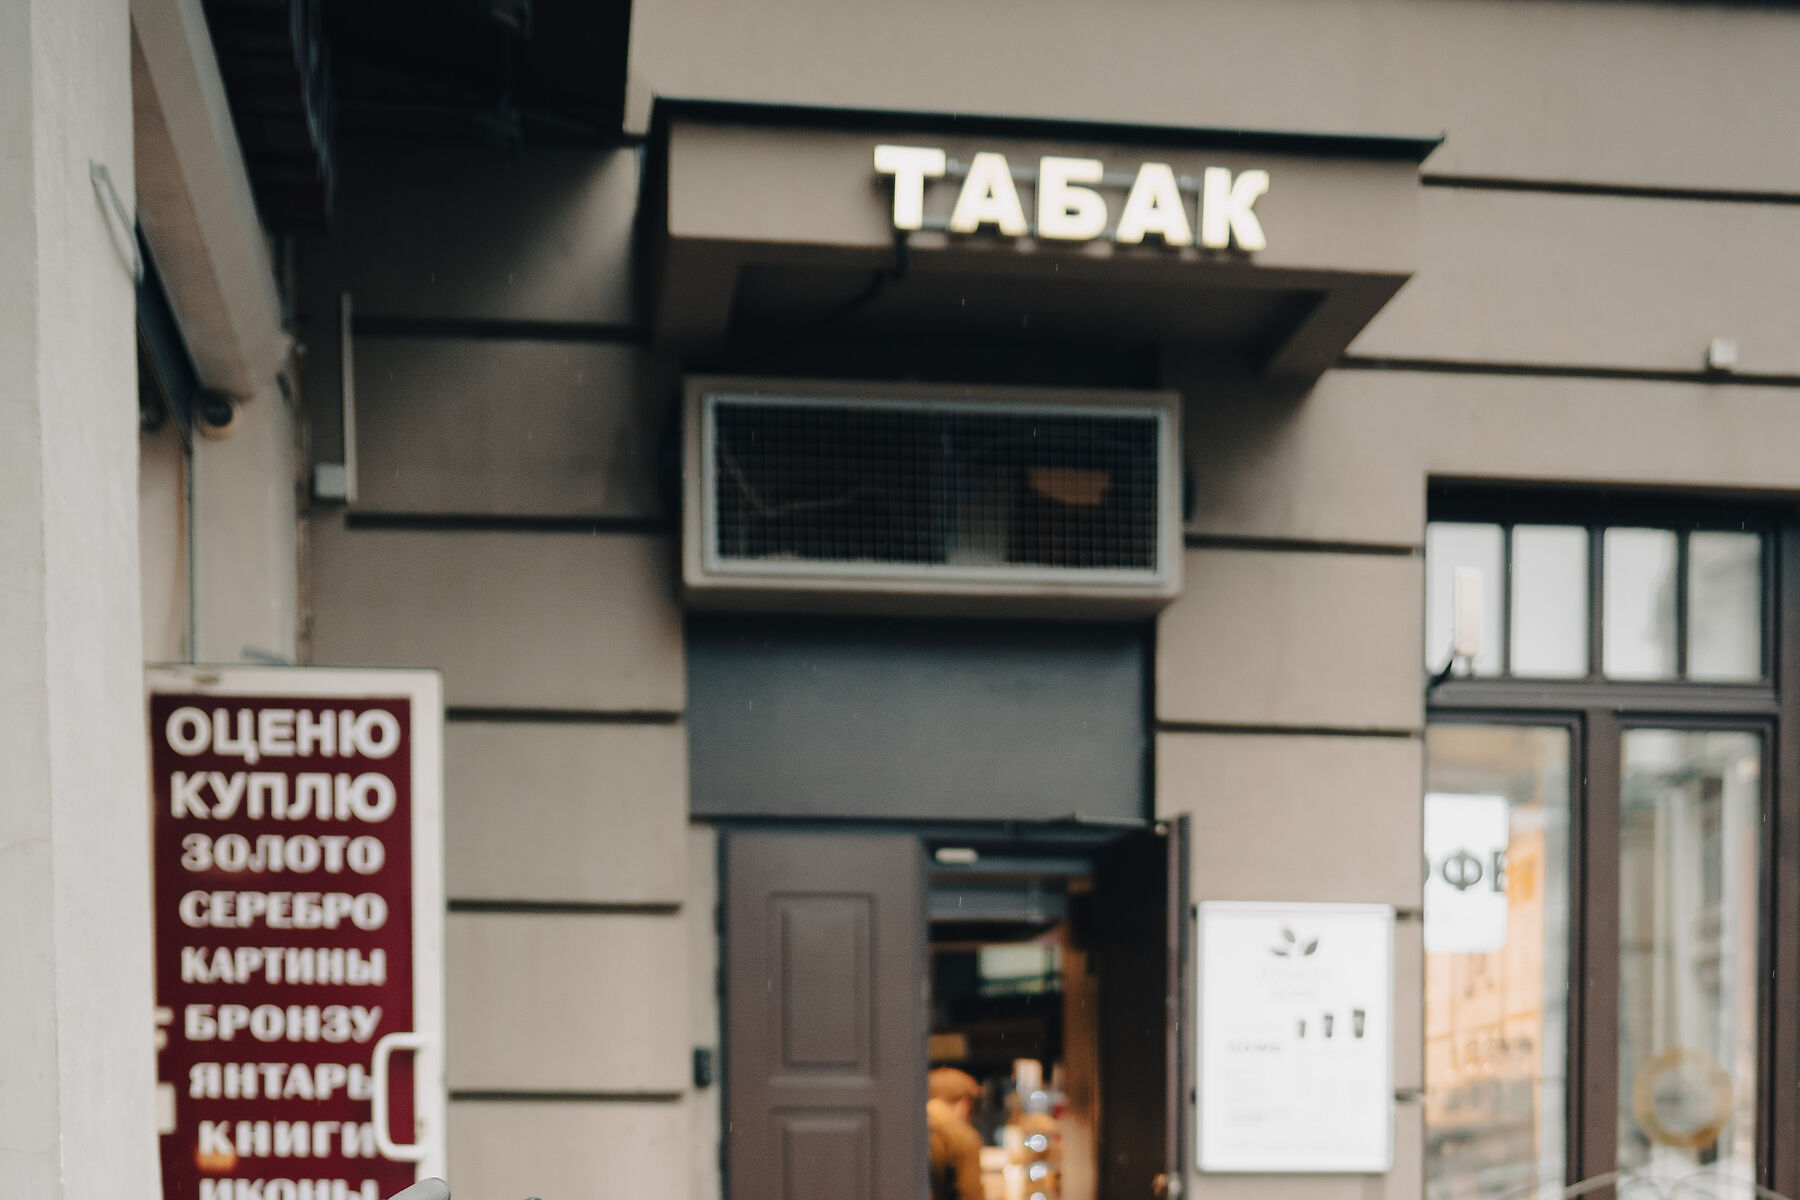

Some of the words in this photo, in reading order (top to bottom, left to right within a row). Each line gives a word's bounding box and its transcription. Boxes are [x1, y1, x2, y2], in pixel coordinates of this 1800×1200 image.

[873, 145, 1270, 250] ТАБАК
[165, 706, 401, 765] ОЦЕНЮ
[170, 771, 397, 823] КУПЛЮ
[181, 833, 385, 874] ЗОЛОТО
[179, 890, 388, 930] СЕРЕБРО
[181, 946, 387, 986] КАРТИНЫ
[184, 1004, 383, 1044] БРОНЗУ
[189, 1062, 376, 1101] ЯНТАРЬ
[198, 1119, 376, 1160] КНИГИ
